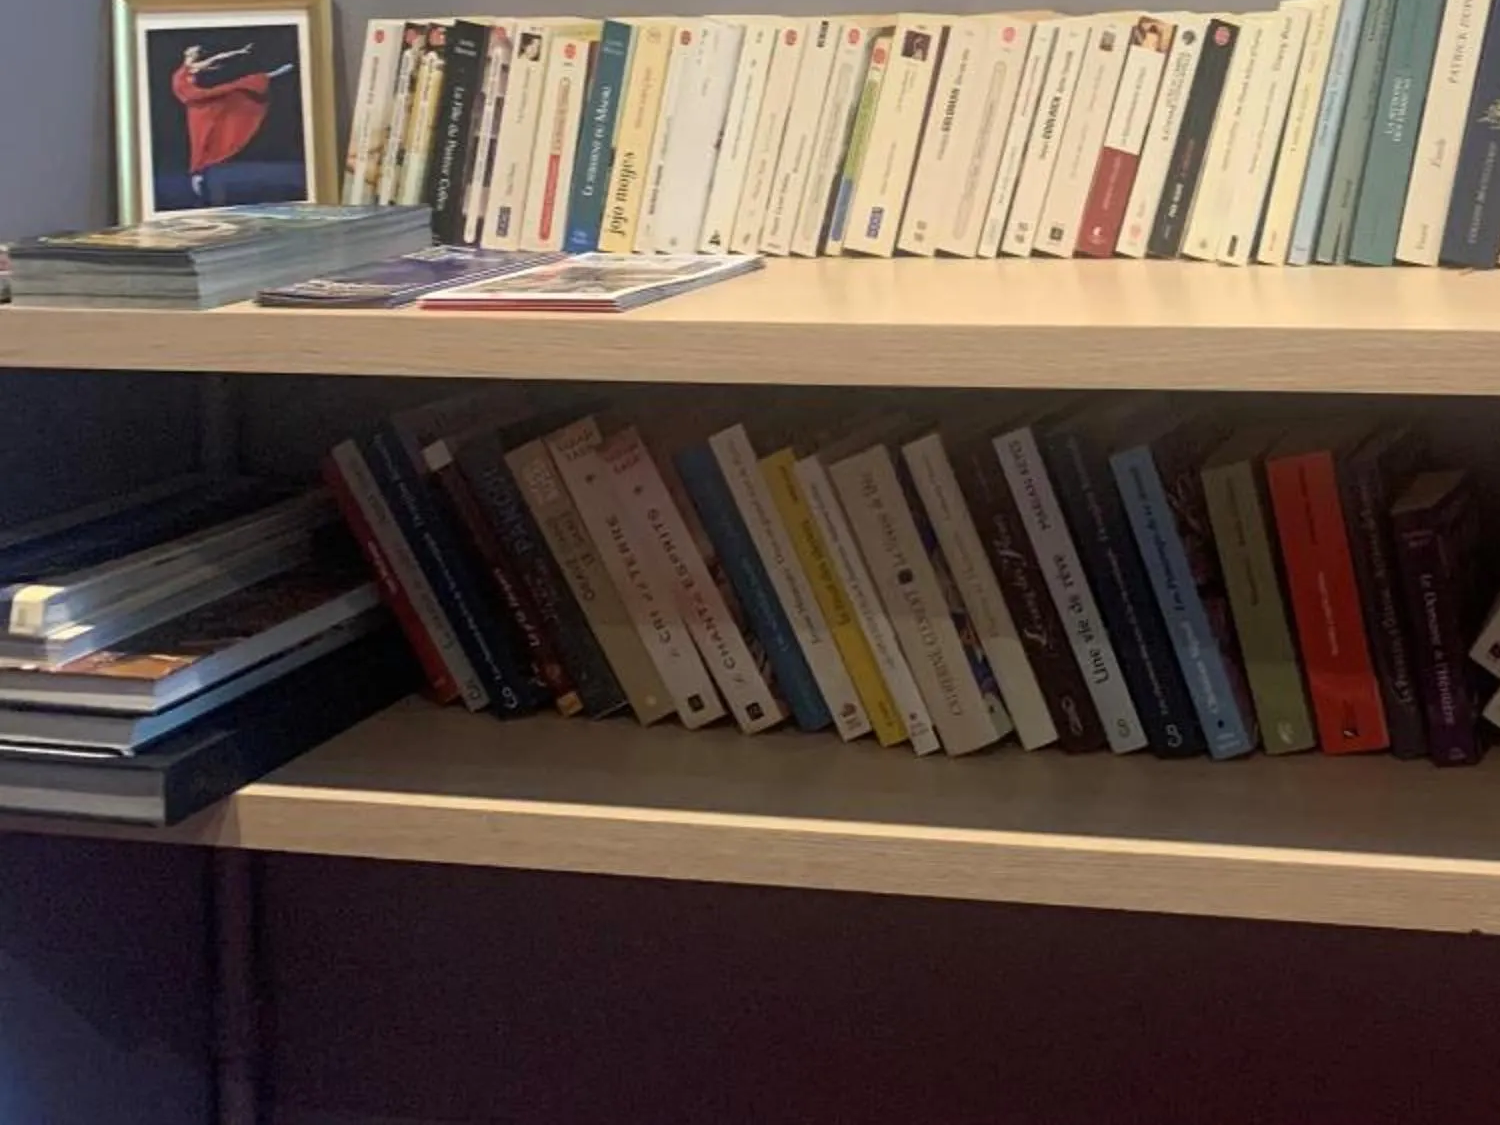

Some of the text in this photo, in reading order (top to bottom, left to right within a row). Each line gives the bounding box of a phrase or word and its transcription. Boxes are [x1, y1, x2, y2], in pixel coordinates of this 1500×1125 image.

[1445, 28, 1467, 85] PATRICK
[606, 206, 629, 236] jojo
[1022, 477, 1053, 532] MARIAN
[600, 513, 646, 583] TERRE
[644, 505, 697, 591] ESPRITS
[1418, 571, 1435, 588] Le
[646, 609, 673, 645] CRI
[694, 604, 737, 671] CHANT
[1047, 552, 1111, 686] Une vie de rêve
